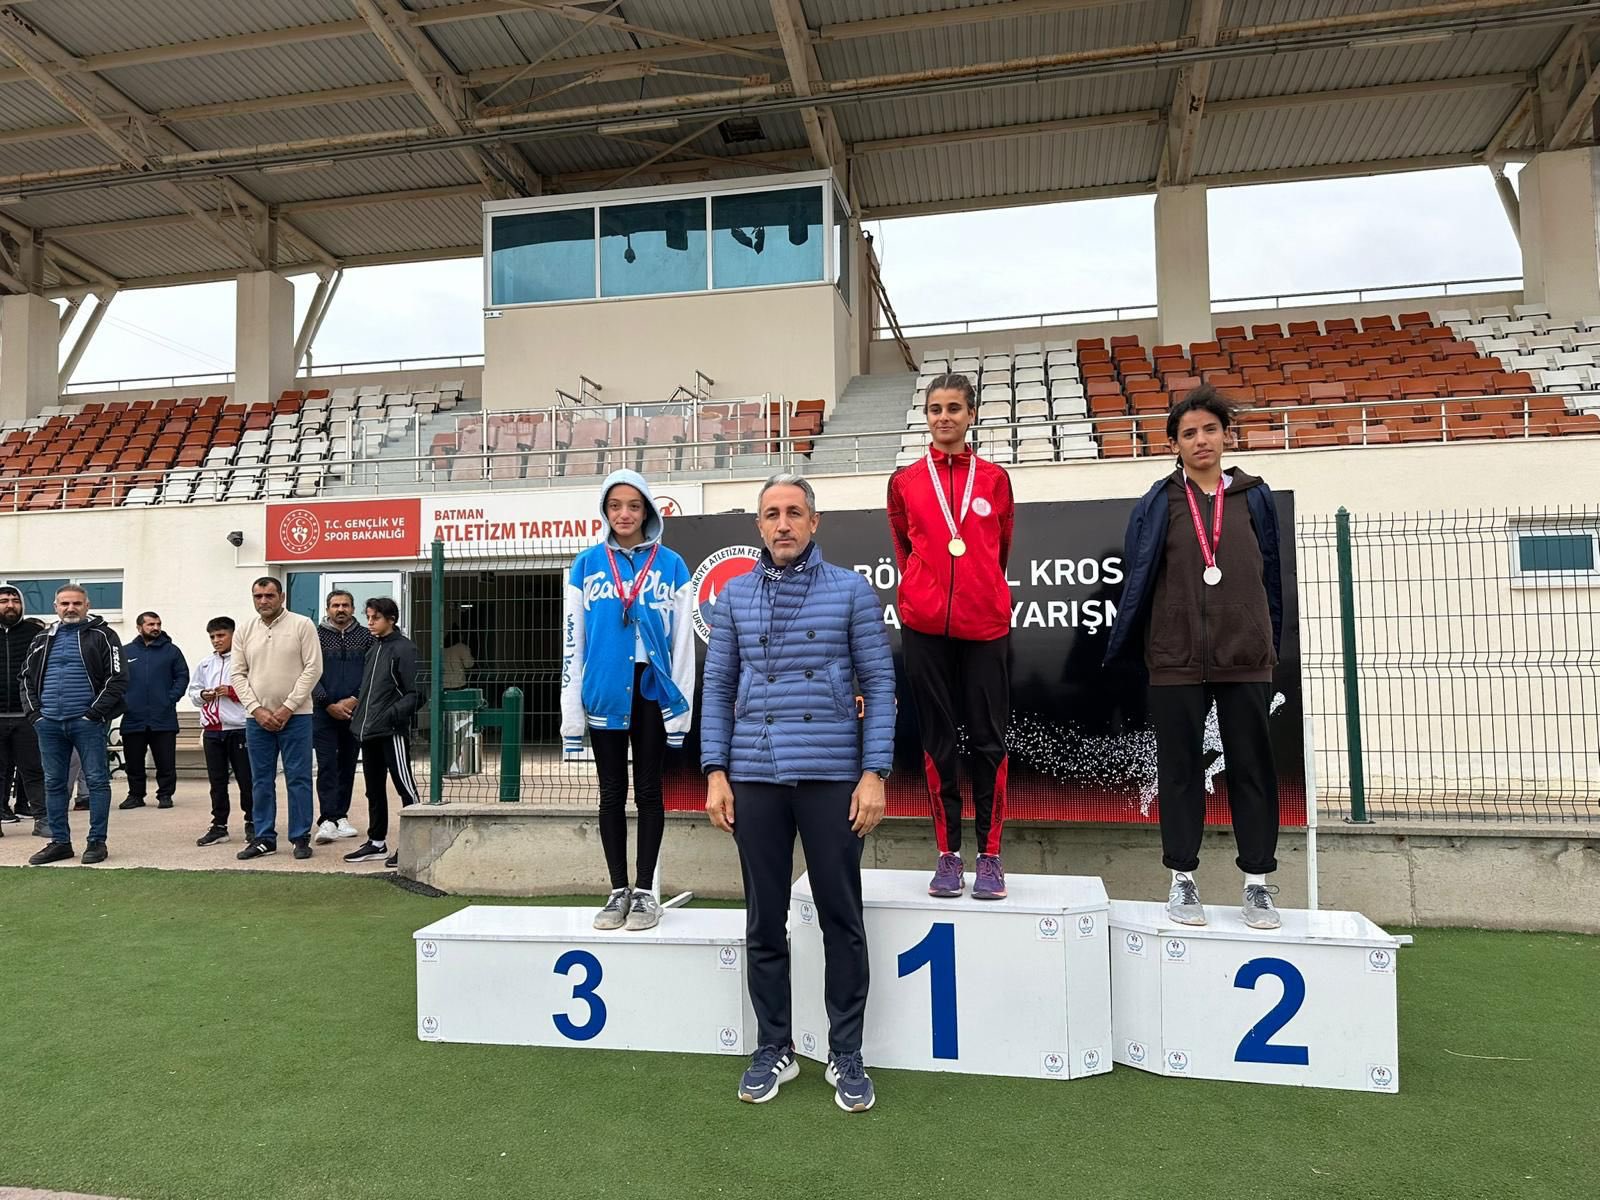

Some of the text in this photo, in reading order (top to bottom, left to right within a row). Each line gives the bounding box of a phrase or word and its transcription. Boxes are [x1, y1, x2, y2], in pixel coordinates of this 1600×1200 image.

[324, 517, 405, 530] T.C. GENÇLİK VE
[434, 508, 484, 521] BATMAN
[324, 529, 405, 541] SPOR BAKANLIĞI
[434, 519, 602, 542] ATLETİZM TARTAN P
[1031, 556, 1124, 586] KROS
[552, 949, 607, 1042] 3
[897, 922, 959, 1060] 1
[1233, 957, 1310, 1066] 2
